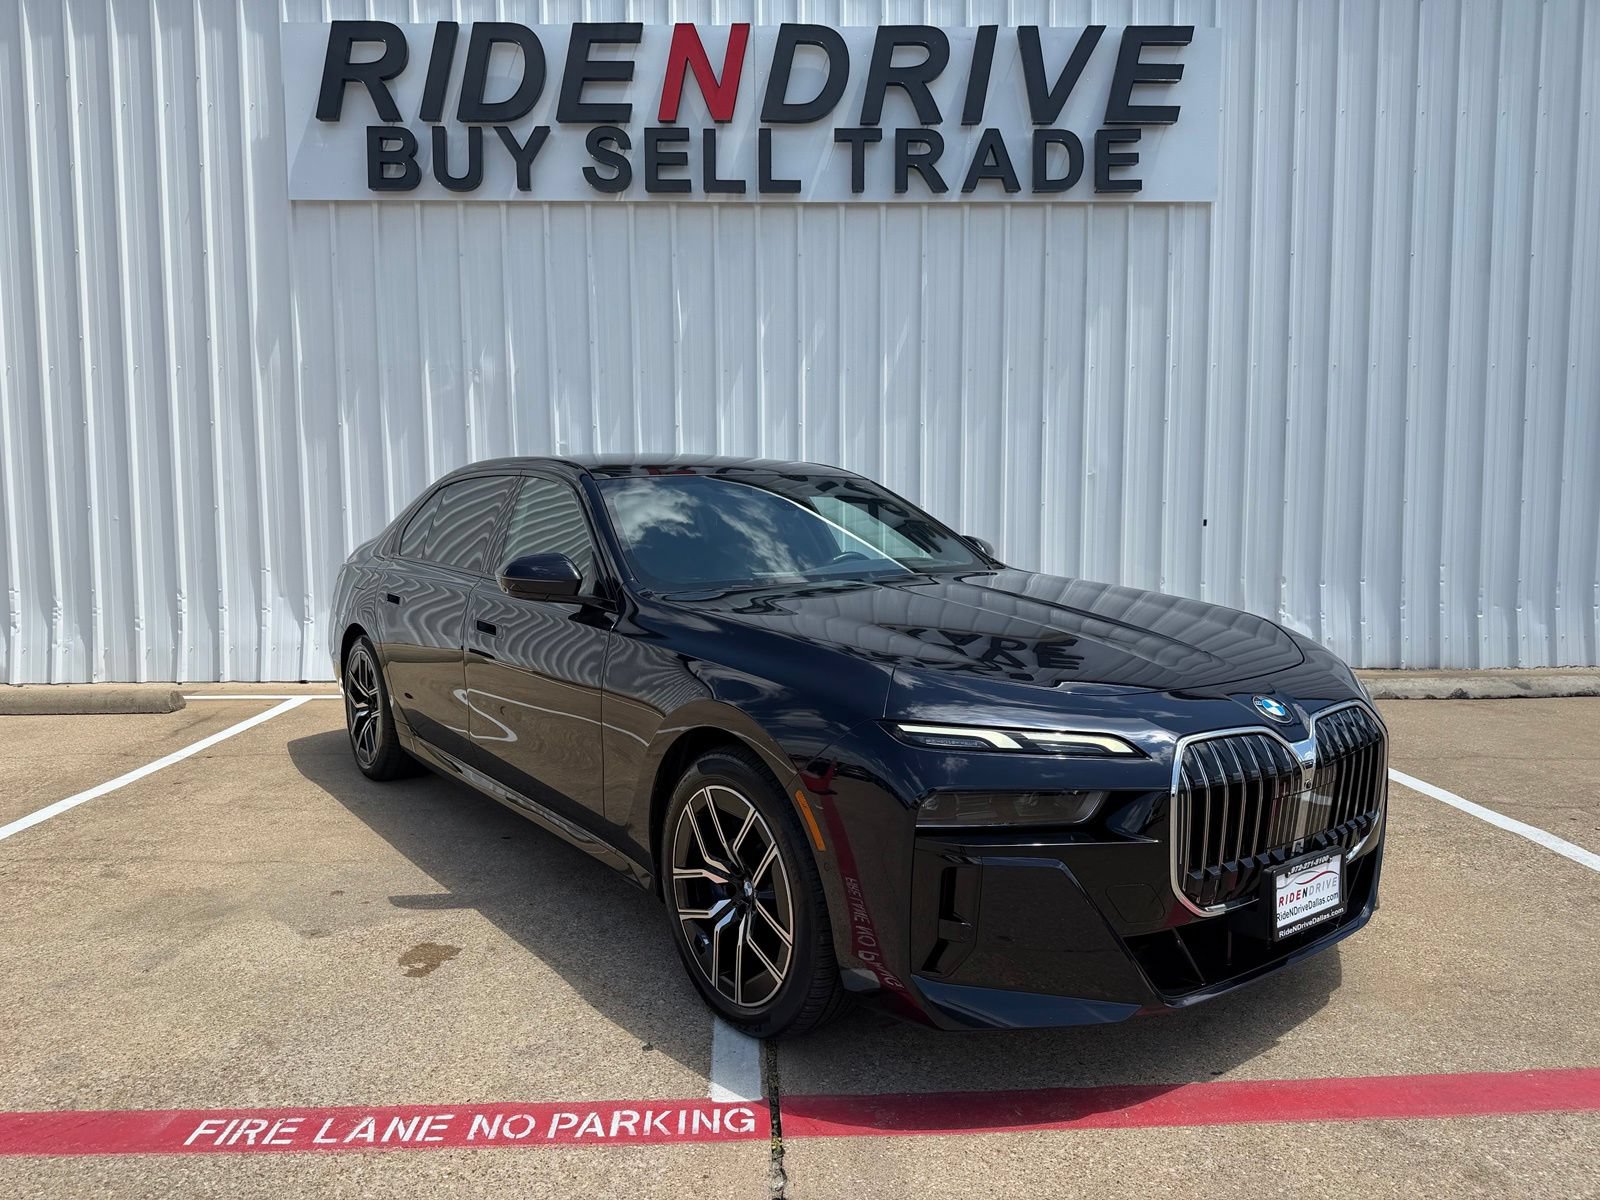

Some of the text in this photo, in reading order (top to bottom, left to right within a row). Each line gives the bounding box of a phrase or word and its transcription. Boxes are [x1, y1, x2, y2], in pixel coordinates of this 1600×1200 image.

[316, 20, 1195, 126] RIDENDRIVE
[366, 125, 1143, 194] BUY SELL TRADE
[1277, 892, 1339, 922] RideNDriveDallas.com
[1278, 876, 1338, 908] RIDENDRIVE
[1278, 907, 1345, 939] RideNDriveDallas.com
[183, 1107, 756, 1146] FIRE LANE NO PARKING
